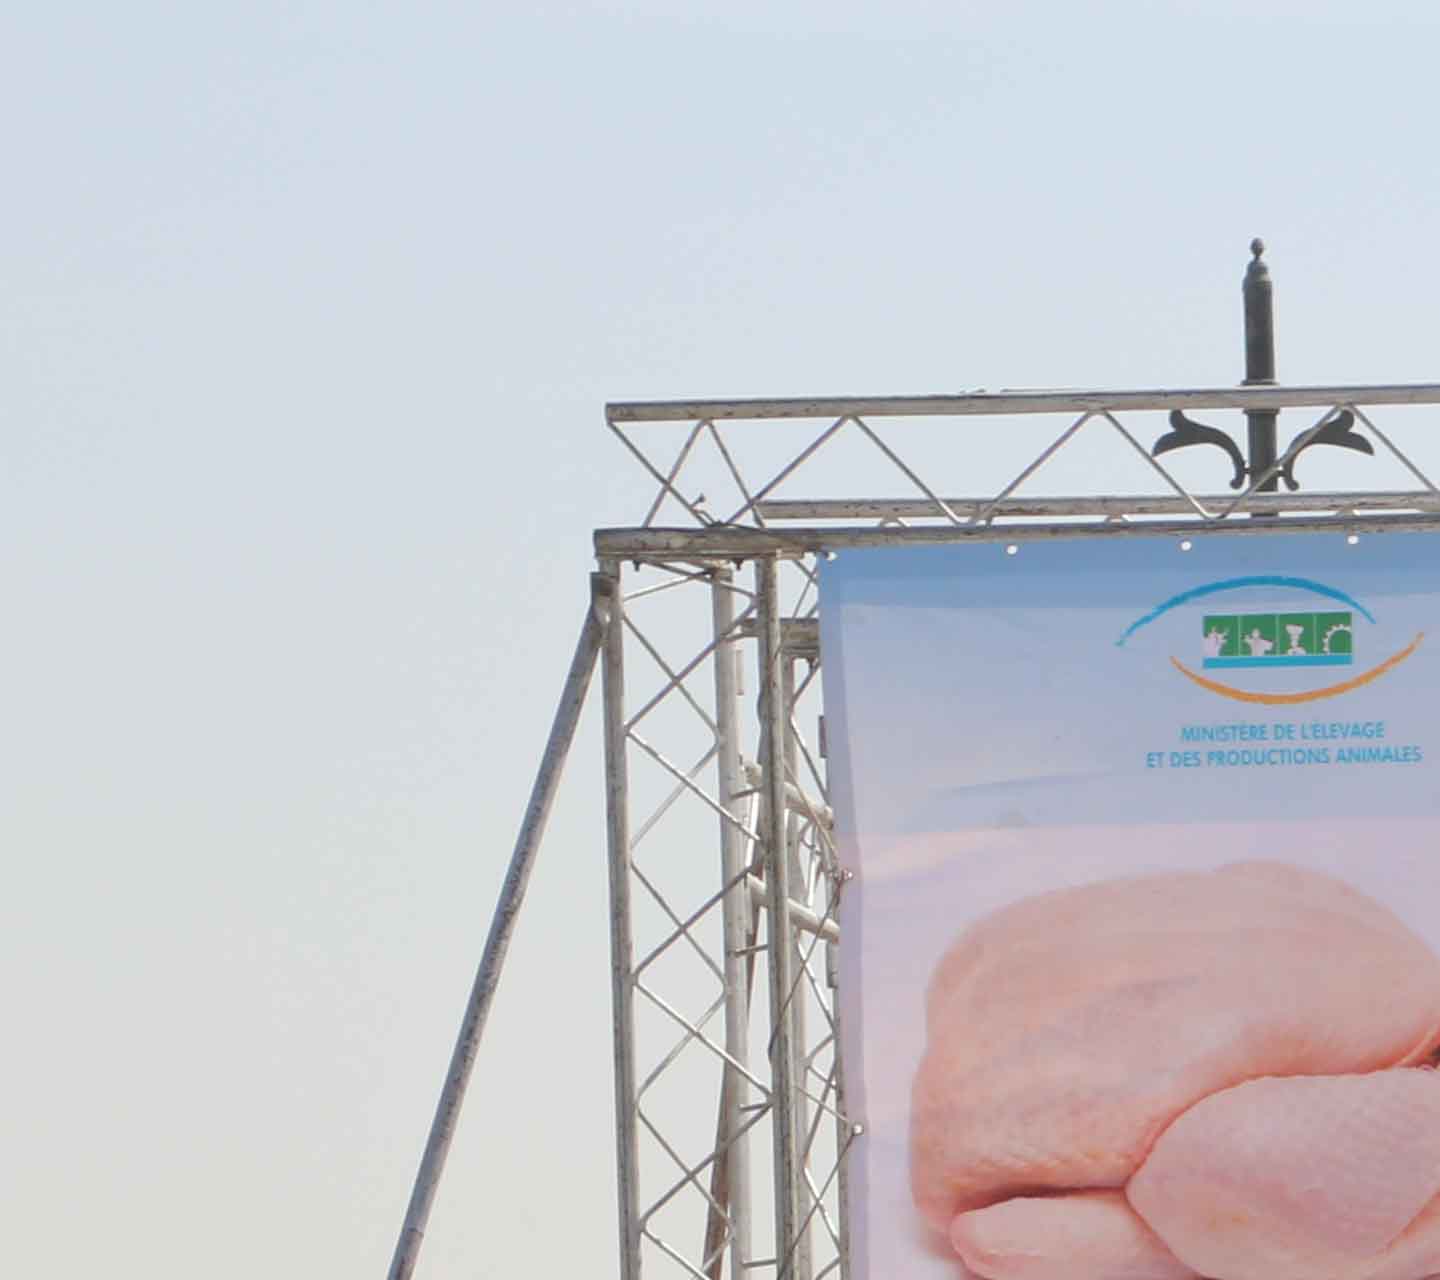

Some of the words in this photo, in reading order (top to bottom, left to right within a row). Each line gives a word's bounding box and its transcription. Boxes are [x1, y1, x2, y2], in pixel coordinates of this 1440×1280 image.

[1180, 720, 1268, 743] MINISTÈRE
[1273, 723, 1296, 740] DE
[1145, 751, 1165, 768] ET
[1170, 750, 1201, 768] DES
[1207, 748, 1329, 767] PRODUCTIONS
[1336, 745, 1423, 765] ANIMALES
